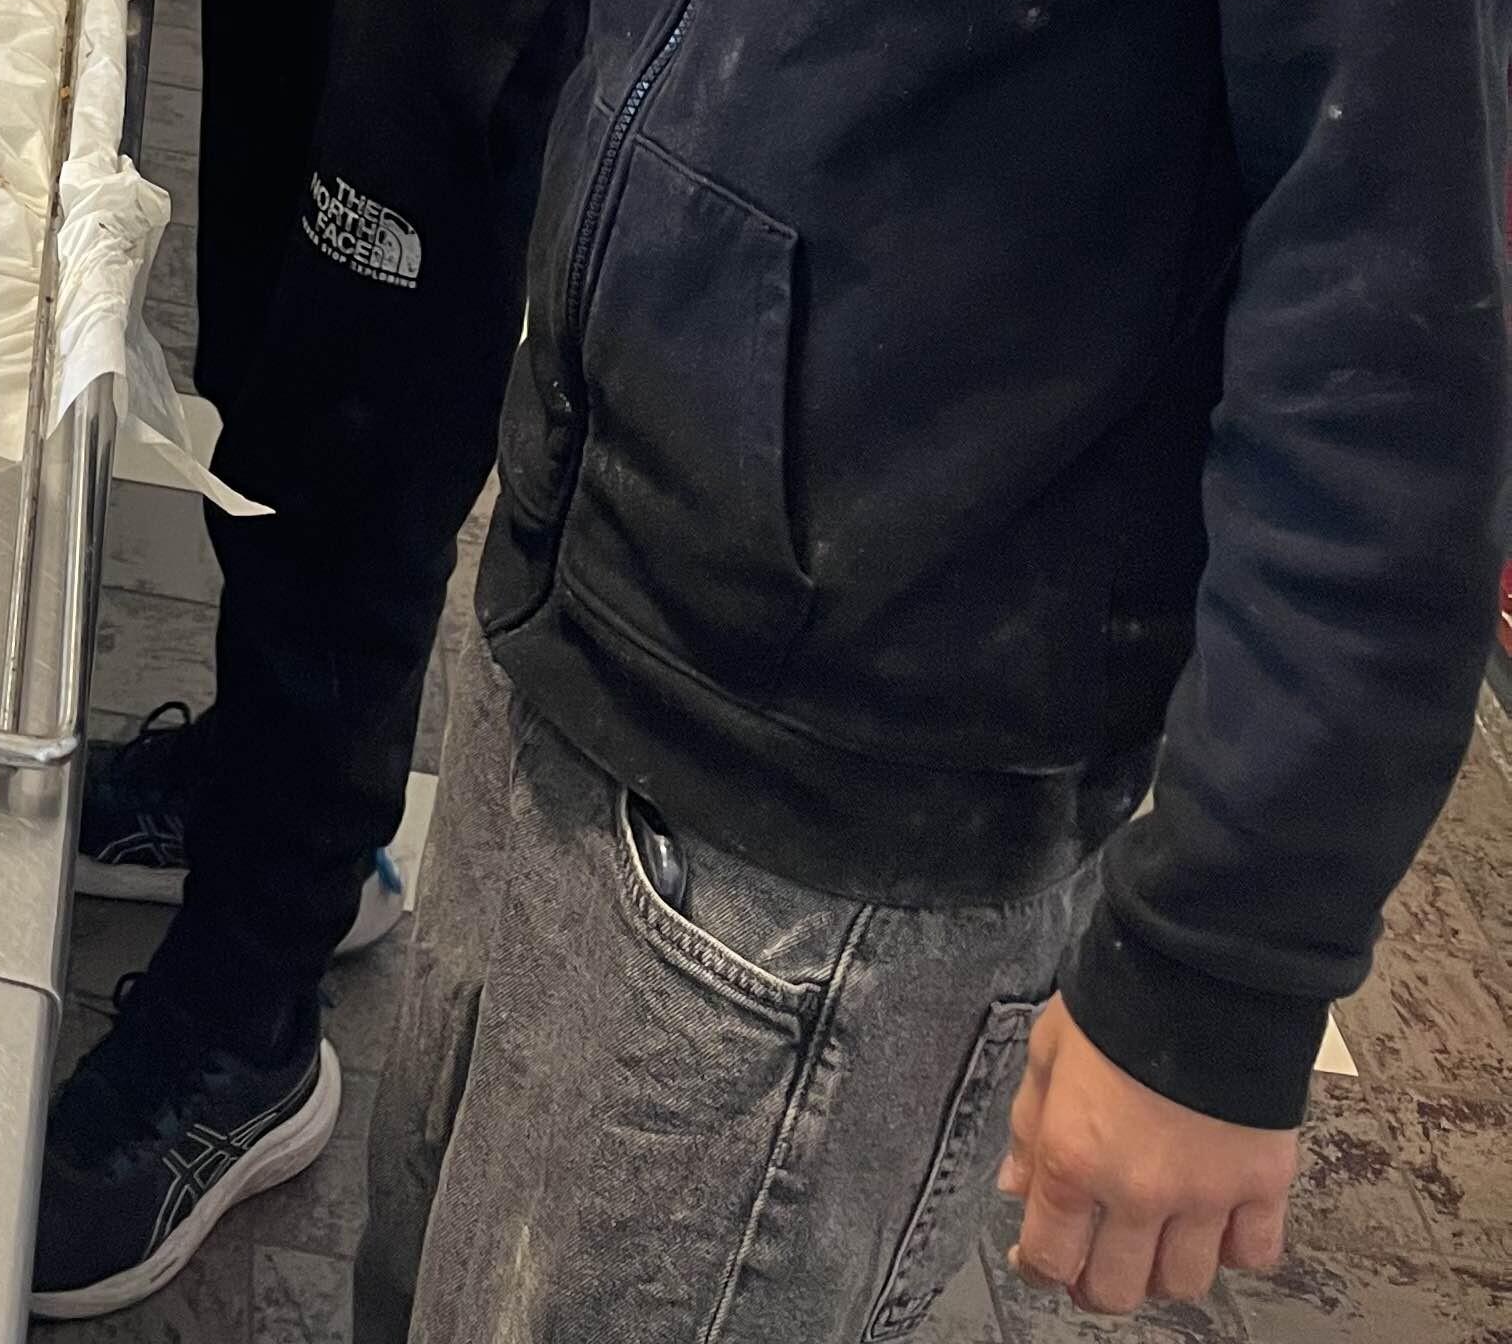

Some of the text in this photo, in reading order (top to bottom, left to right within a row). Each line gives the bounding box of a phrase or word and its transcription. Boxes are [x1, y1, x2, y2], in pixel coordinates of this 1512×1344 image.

[310, 171, 377, 243] NORTH
[336, 176, 382, 223] THE
[316, 211, 372, 265] FACE
